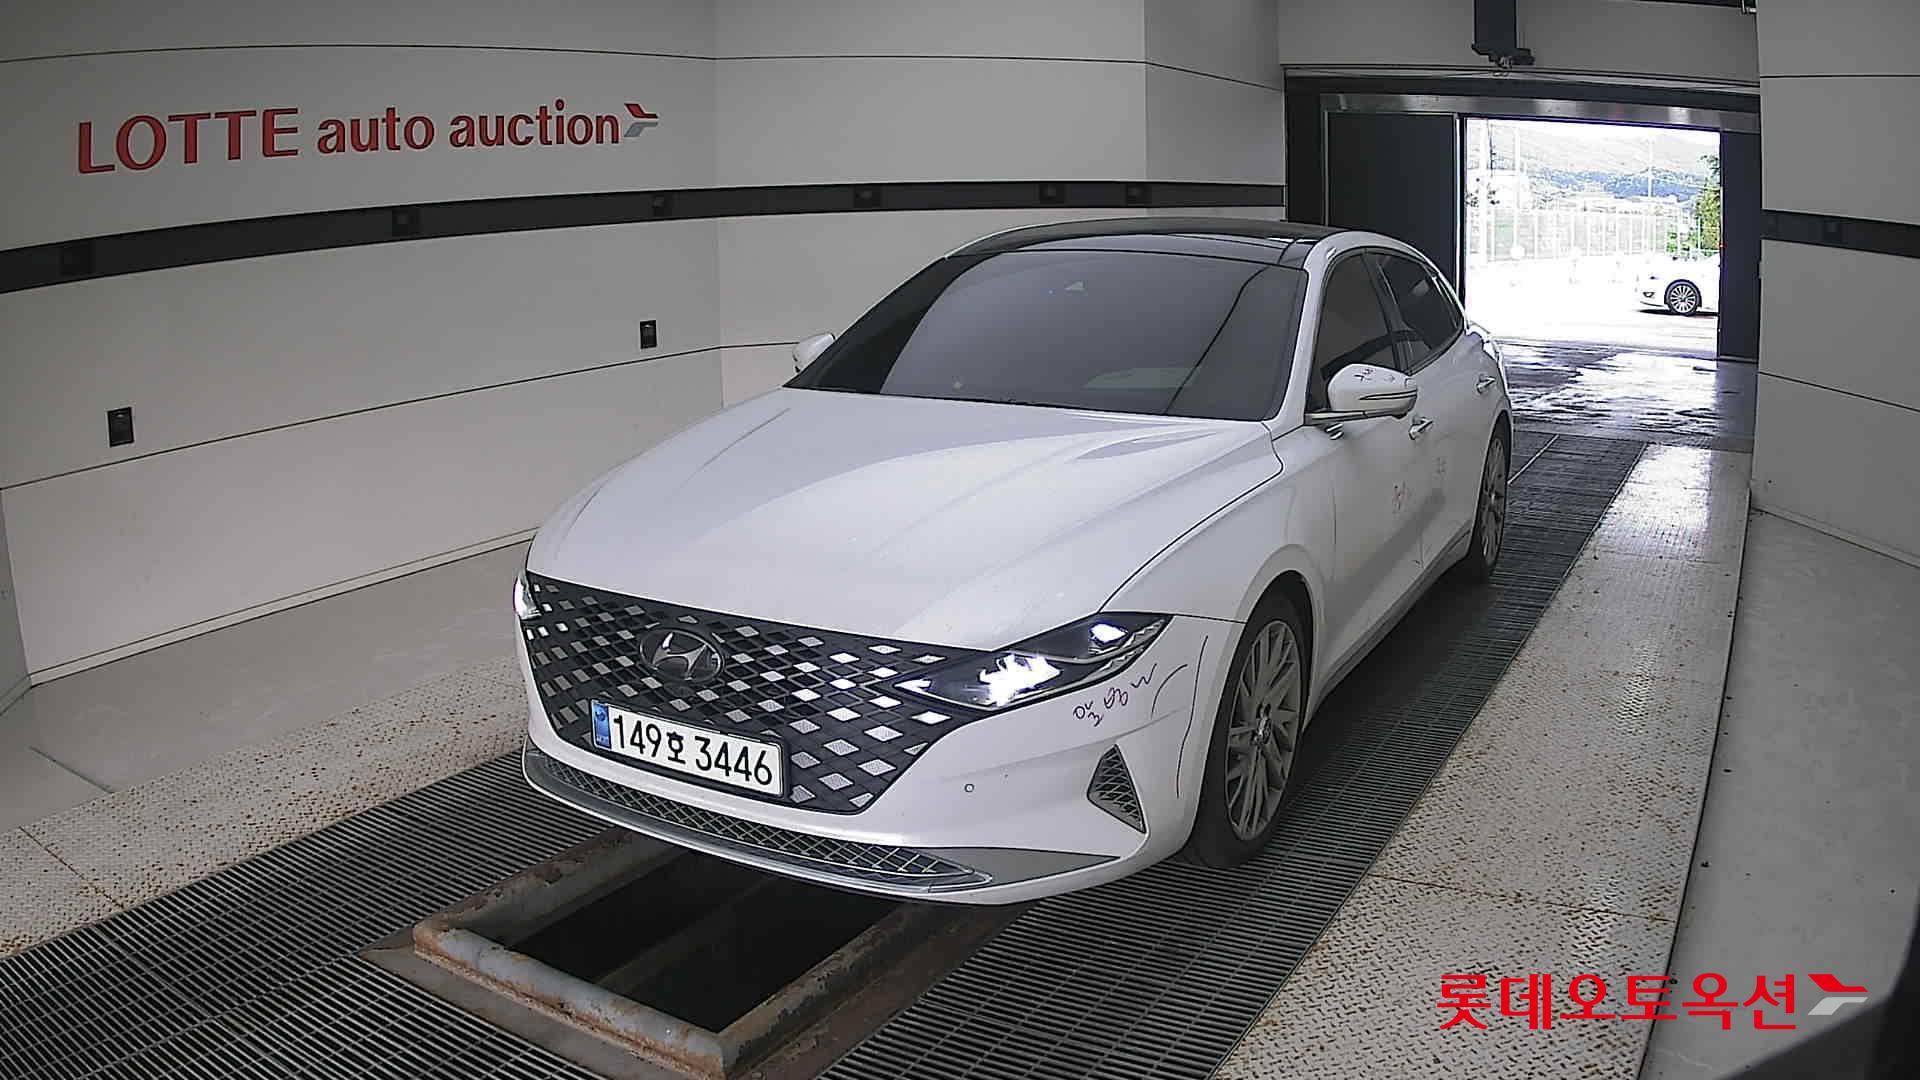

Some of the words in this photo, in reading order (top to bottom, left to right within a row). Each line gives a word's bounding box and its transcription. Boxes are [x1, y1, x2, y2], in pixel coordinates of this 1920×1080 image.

[78, 107, 298, 174] LOTTE
[317, 107, 435, 154] auto
[449, 99, 620, 148] auction
[614, 714, 686, 765] 149호
[694, 735, 773, 786] 3446
